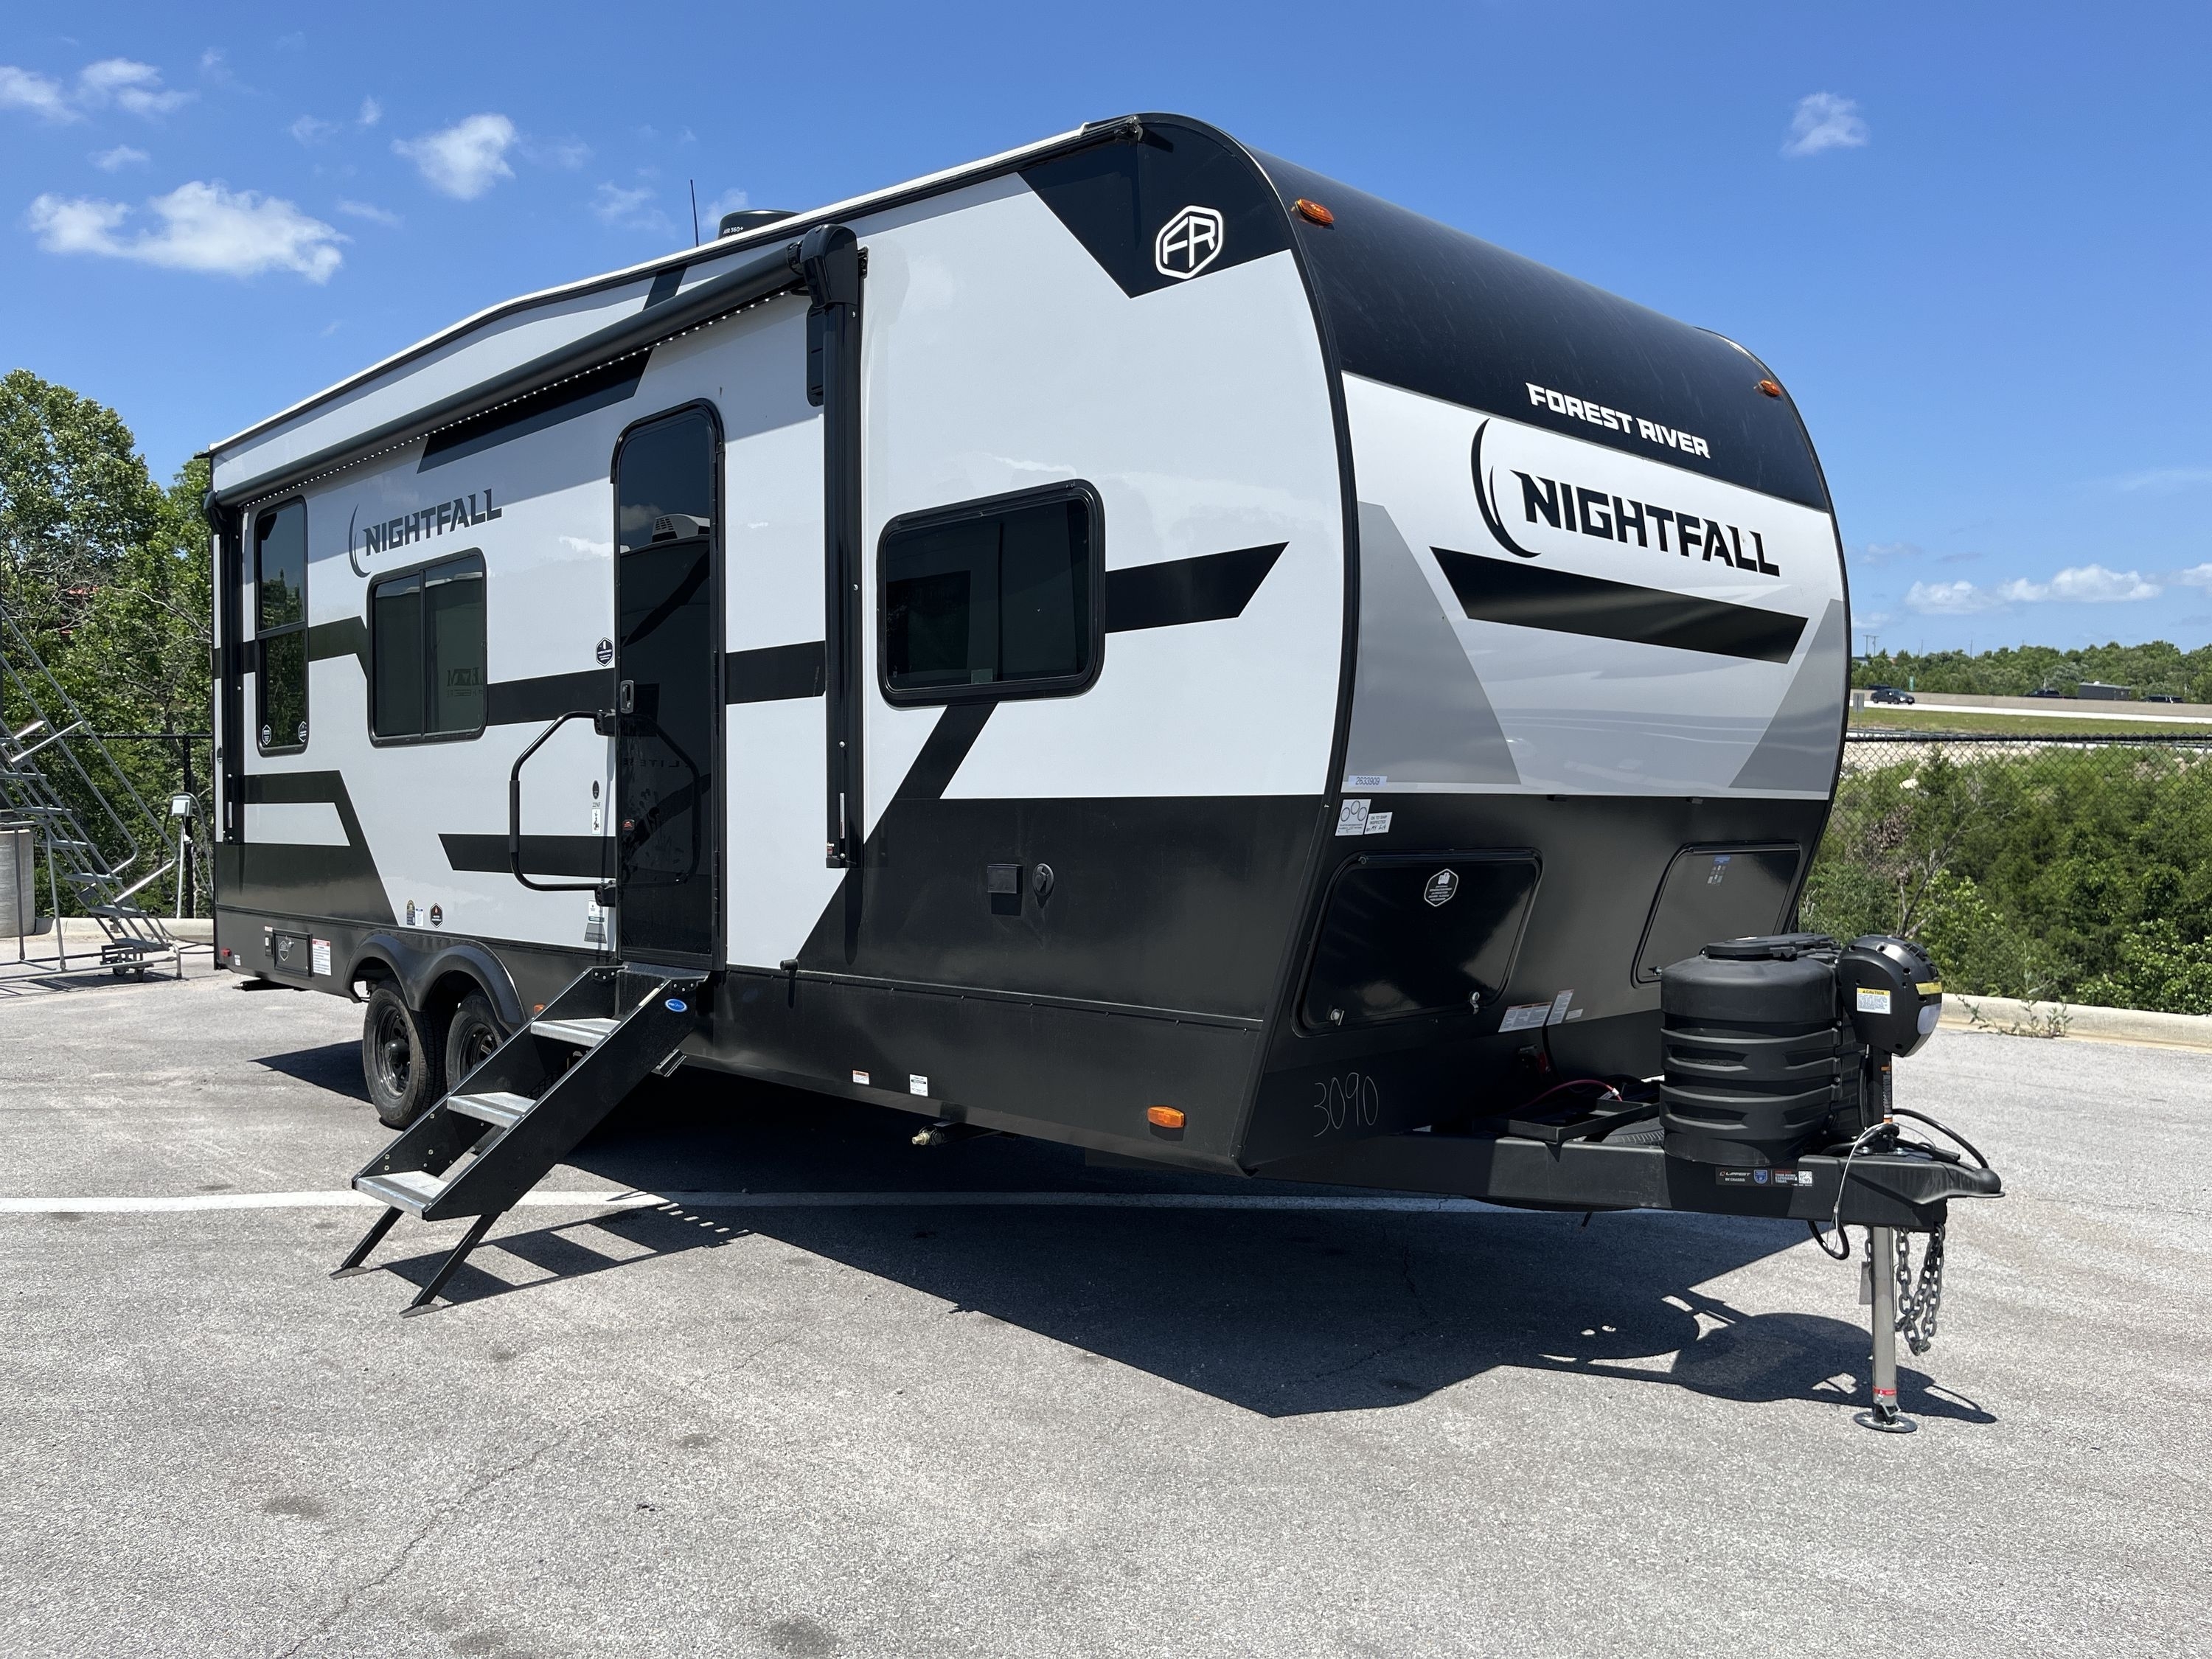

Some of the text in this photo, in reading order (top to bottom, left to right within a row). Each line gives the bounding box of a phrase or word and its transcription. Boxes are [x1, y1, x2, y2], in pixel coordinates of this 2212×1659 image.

[1525, 382, 1711, 459] FOREST RIVER
[362, 488, 503, 557] NIGHTFALL
[1509, 469, 1781, 577] NIGHTFALL
[1355, 776, 1380, 785] 2633909
[1313, 1071, 1380, 1138] 3090
